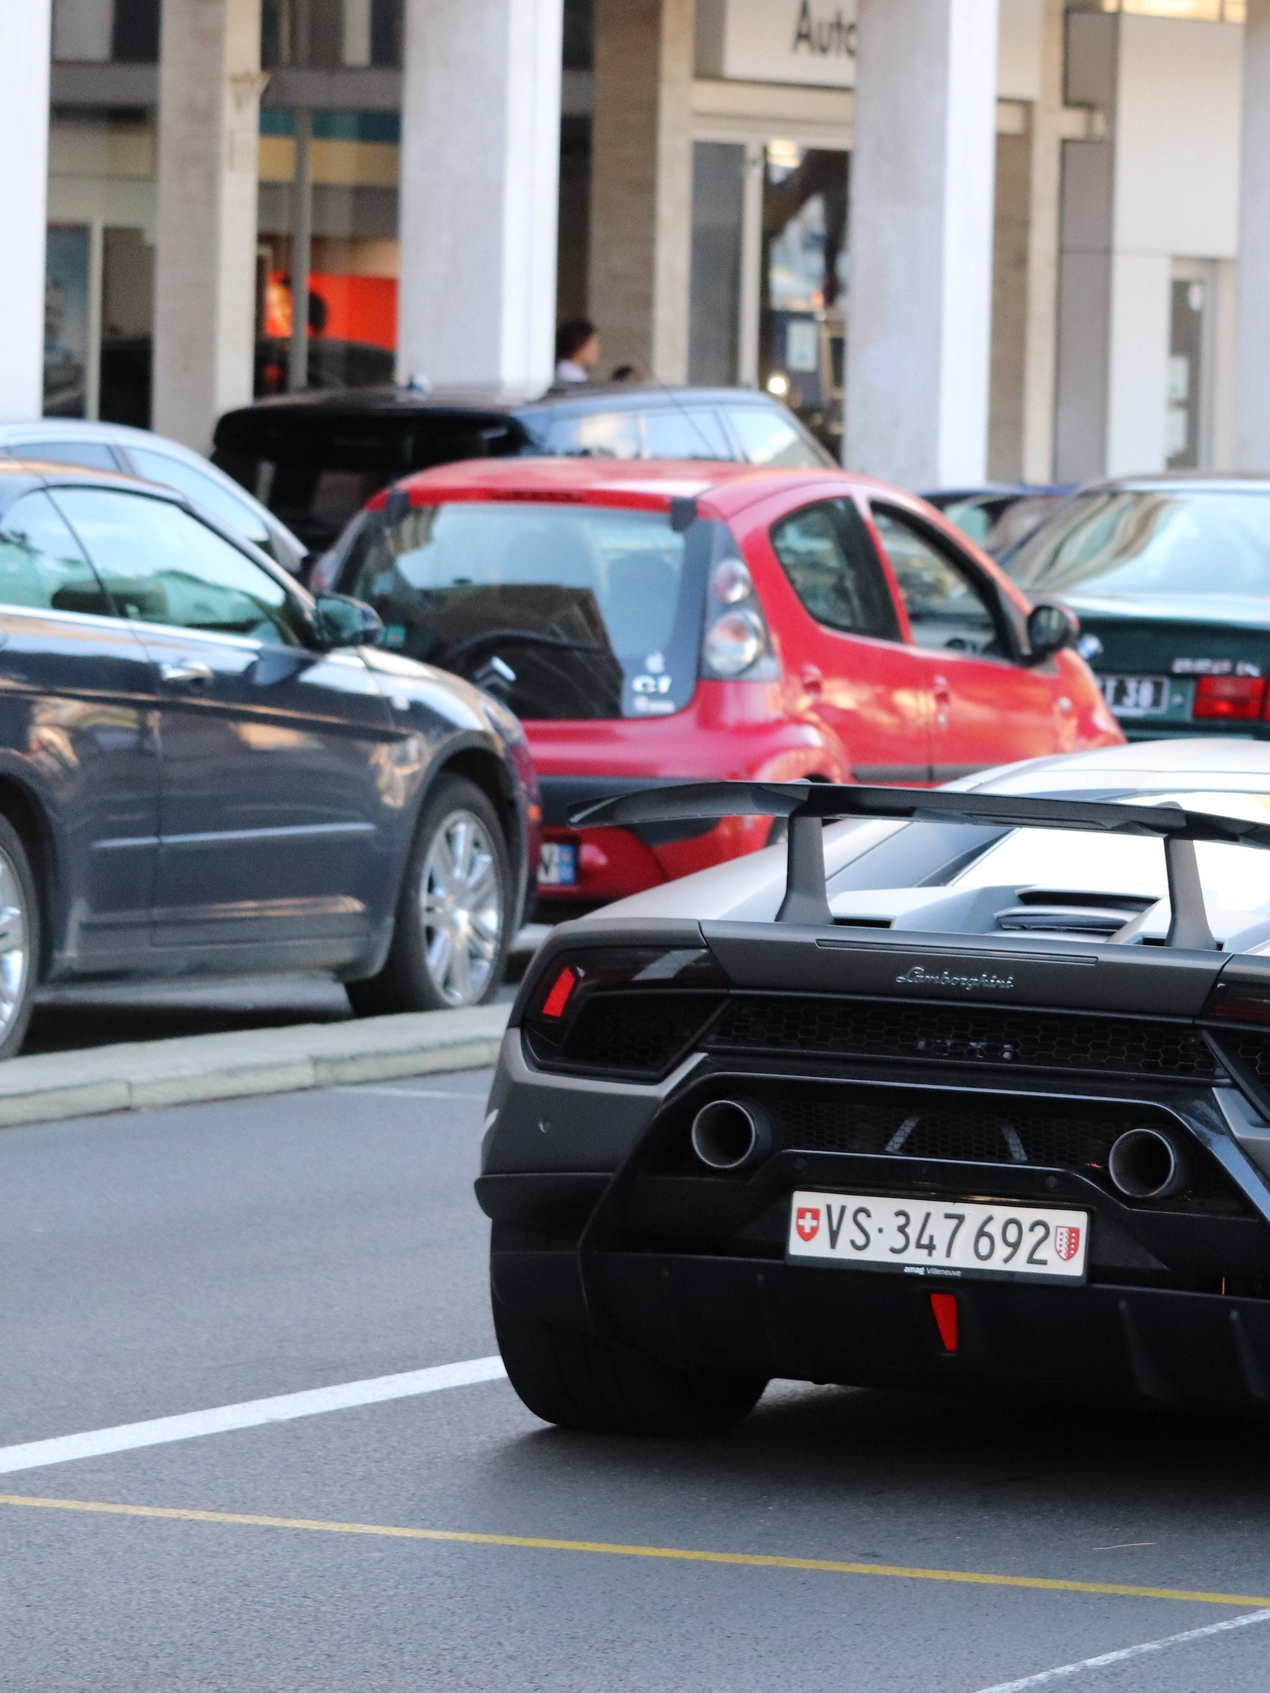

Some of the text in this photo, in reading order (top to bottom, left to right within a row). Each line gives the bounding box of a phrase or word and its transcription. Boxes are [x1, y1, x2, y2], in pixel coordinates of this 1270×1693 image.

[896, 966, 1014, 990] Lamborghini
[904, 1266, 962, 1277] amag Villeneuve
